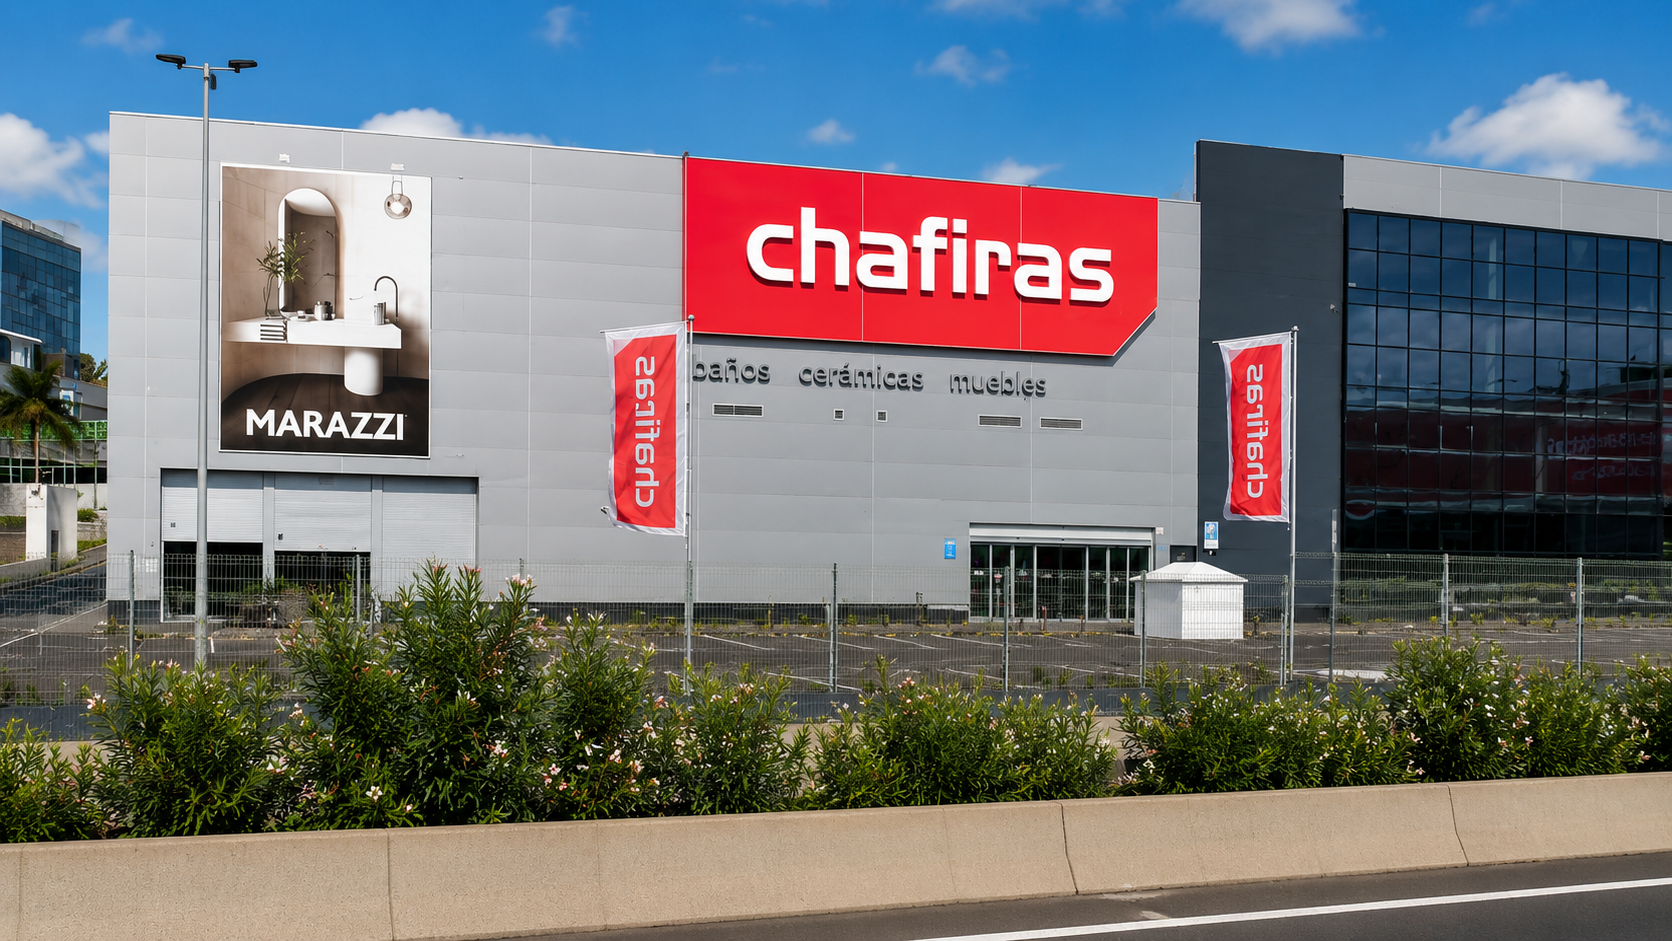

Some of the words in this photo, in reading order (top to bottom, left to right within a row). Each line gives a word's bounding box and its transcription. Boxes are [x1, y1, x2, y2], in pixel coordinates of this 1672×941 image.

[746, 206, 1115, 304] chafiras
[692, 354, 771, 384] baños
[799, 362, 924, 390] cerámicas
[949, 371, 1047, 396] muebles
[246, 408, 405, 441] MARAZZI
